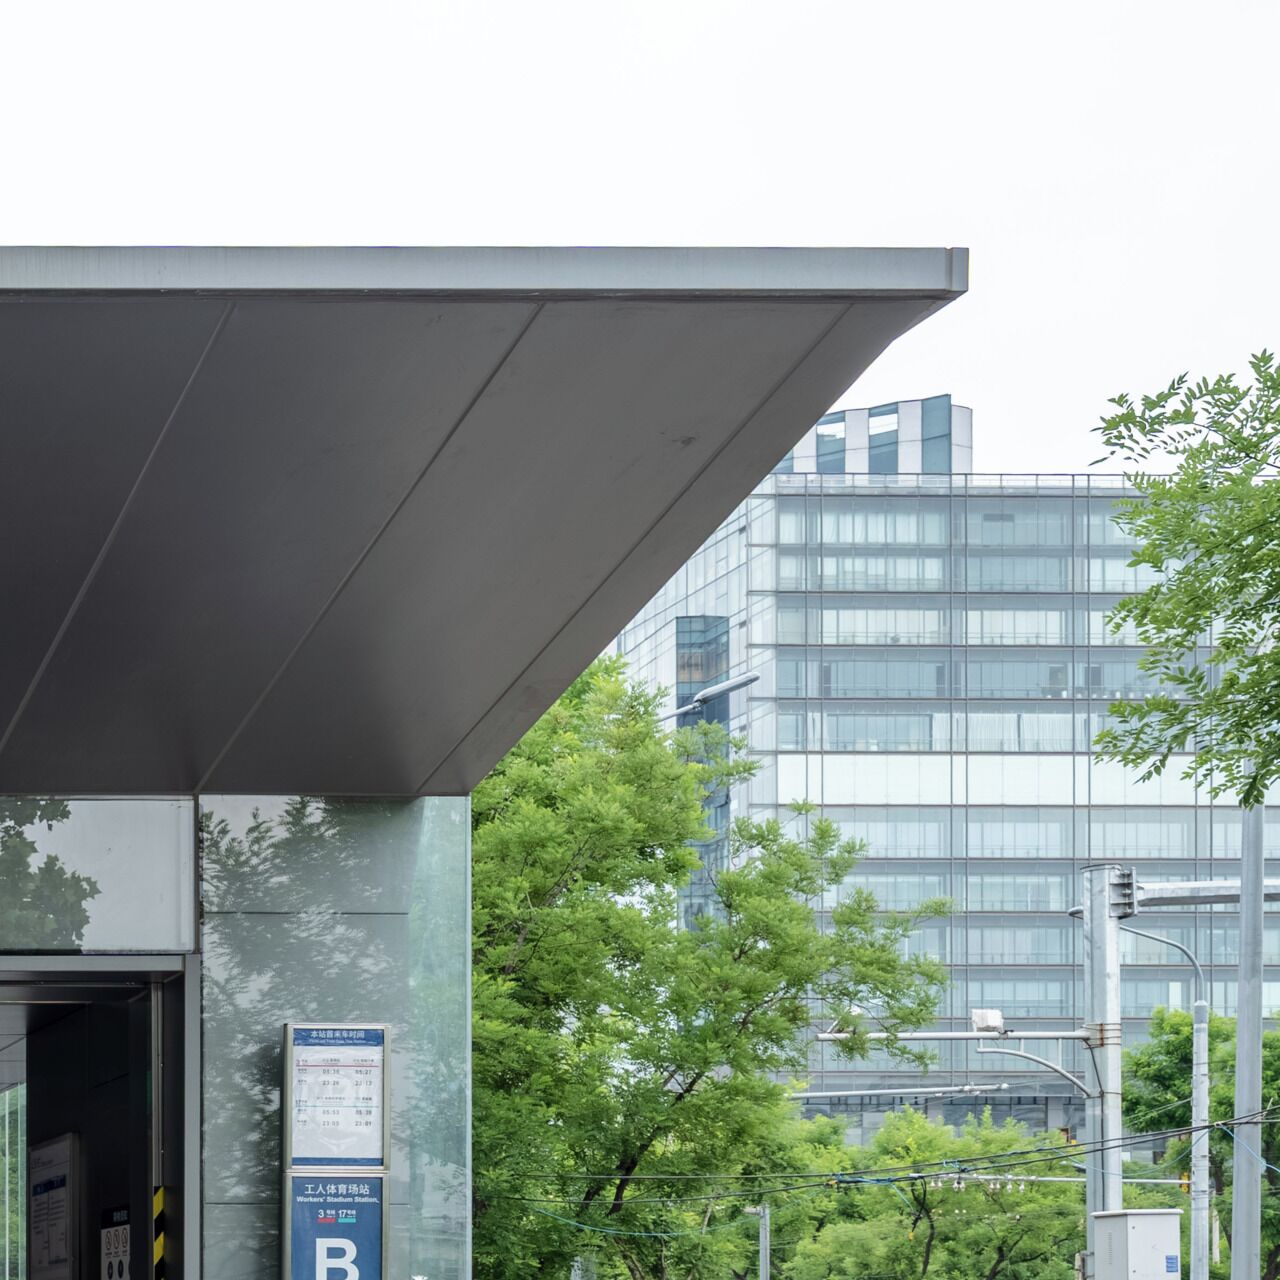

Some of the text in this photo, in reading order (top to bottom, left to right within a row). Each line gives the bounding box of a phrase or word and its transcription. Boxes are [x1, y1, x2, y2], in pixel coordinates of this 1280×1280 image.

[304, 1183, 370, 1195] 工人体育场站
[296, 1195, 325, 1203] Workers'
[326, 1195, 353, 1203] Stadium
